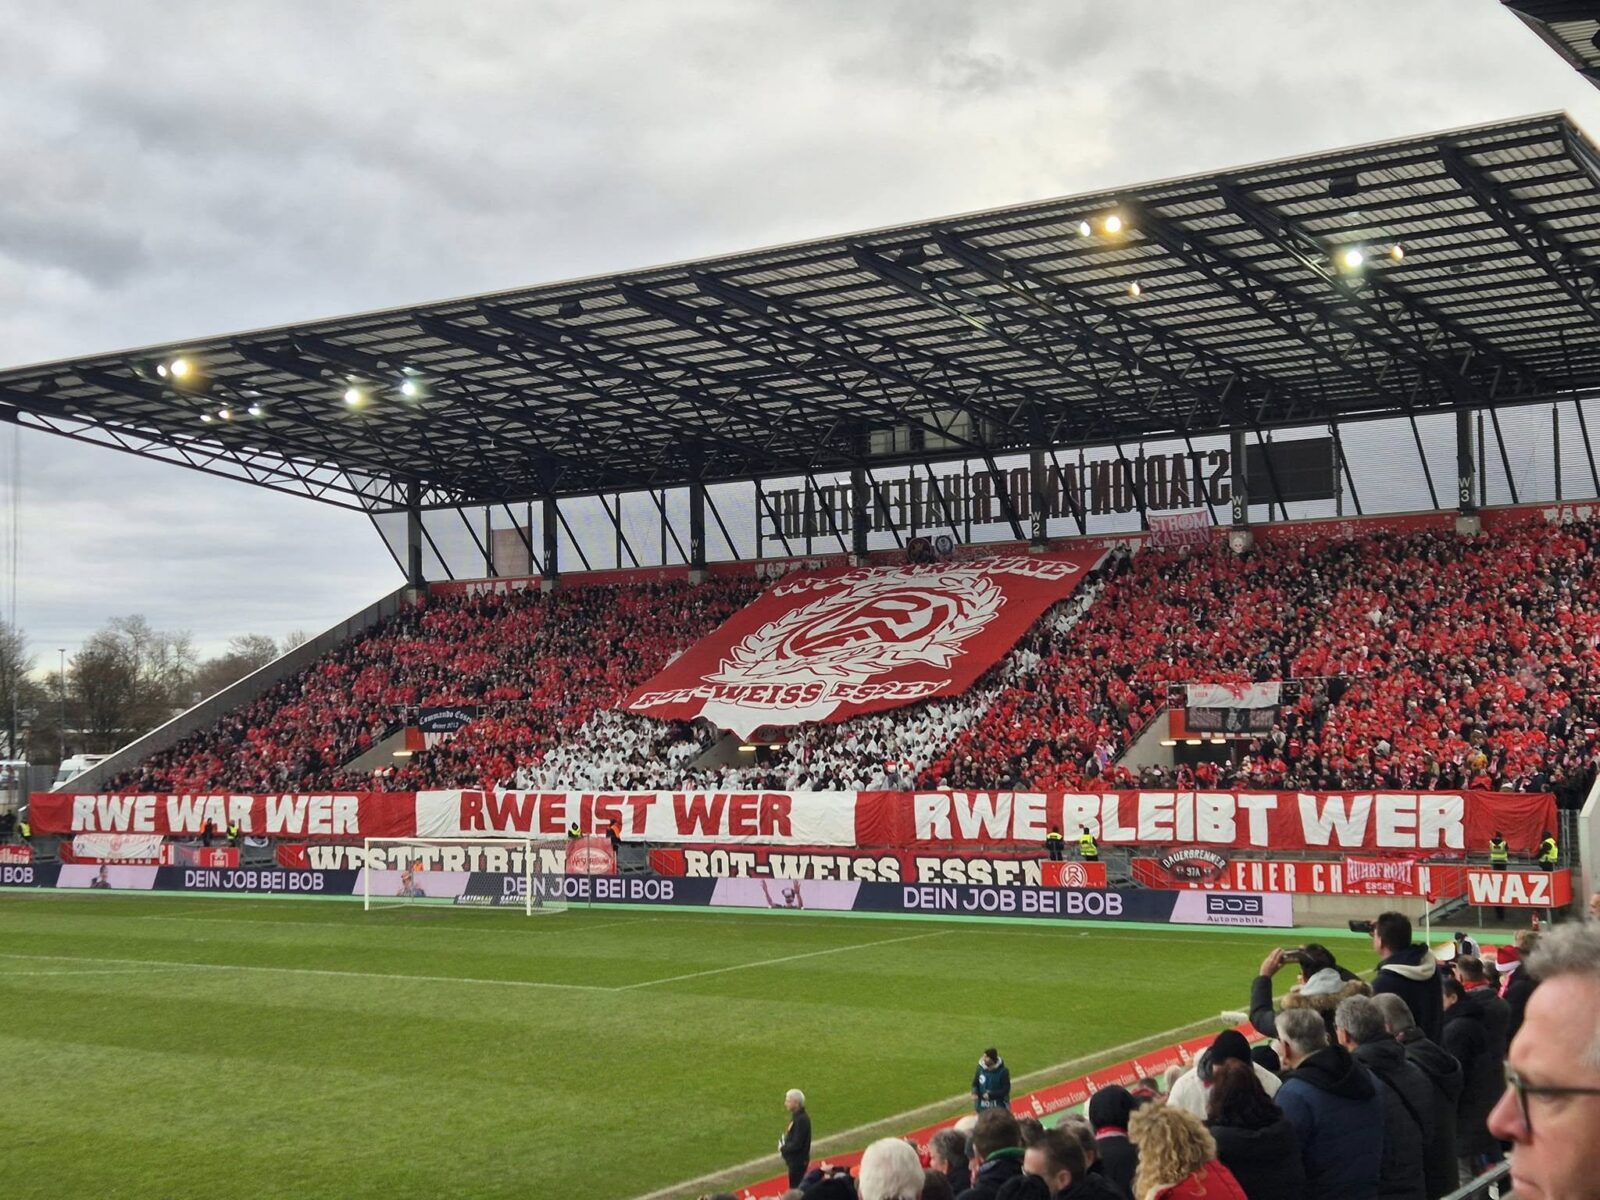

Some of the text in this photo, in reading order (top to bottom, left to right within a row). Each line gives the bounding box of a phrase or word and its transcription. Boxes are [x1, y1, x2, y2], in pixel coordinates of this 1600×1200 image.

[1151, 529, 1210, 545] KASTEN
[71, 795, 360, 834] RWE WAR WER
[459, 792, 791, 837] RWE IST WER
[914, 793, 1465, 849] RWE BLEIBT WER
[685, 850, 1042, 886] ROT-WEISS ESSEN
[1162, 849, 1226, 869] DAUERBRENNER
[1347, 857, 1415, 884] RUHRFRONT
[4, 867, 34, 883] BOB
[186, 870, 324, 890] DEIN JOB BEI BOB
[550, 877, 590, 898] JOB
[595, 879, 626, 899] BEI
[629, 879, 674, 900] BOB
[1469, 873, 1550, 905] WAZ
[903, 887, 1123, 915] DEIN JOB BEI BOB
[1210, 898, 1259, 912] BOB
[1207, 915, 1264, 925] Automobile
[1069, 1091, 1087, 1104] Essen
